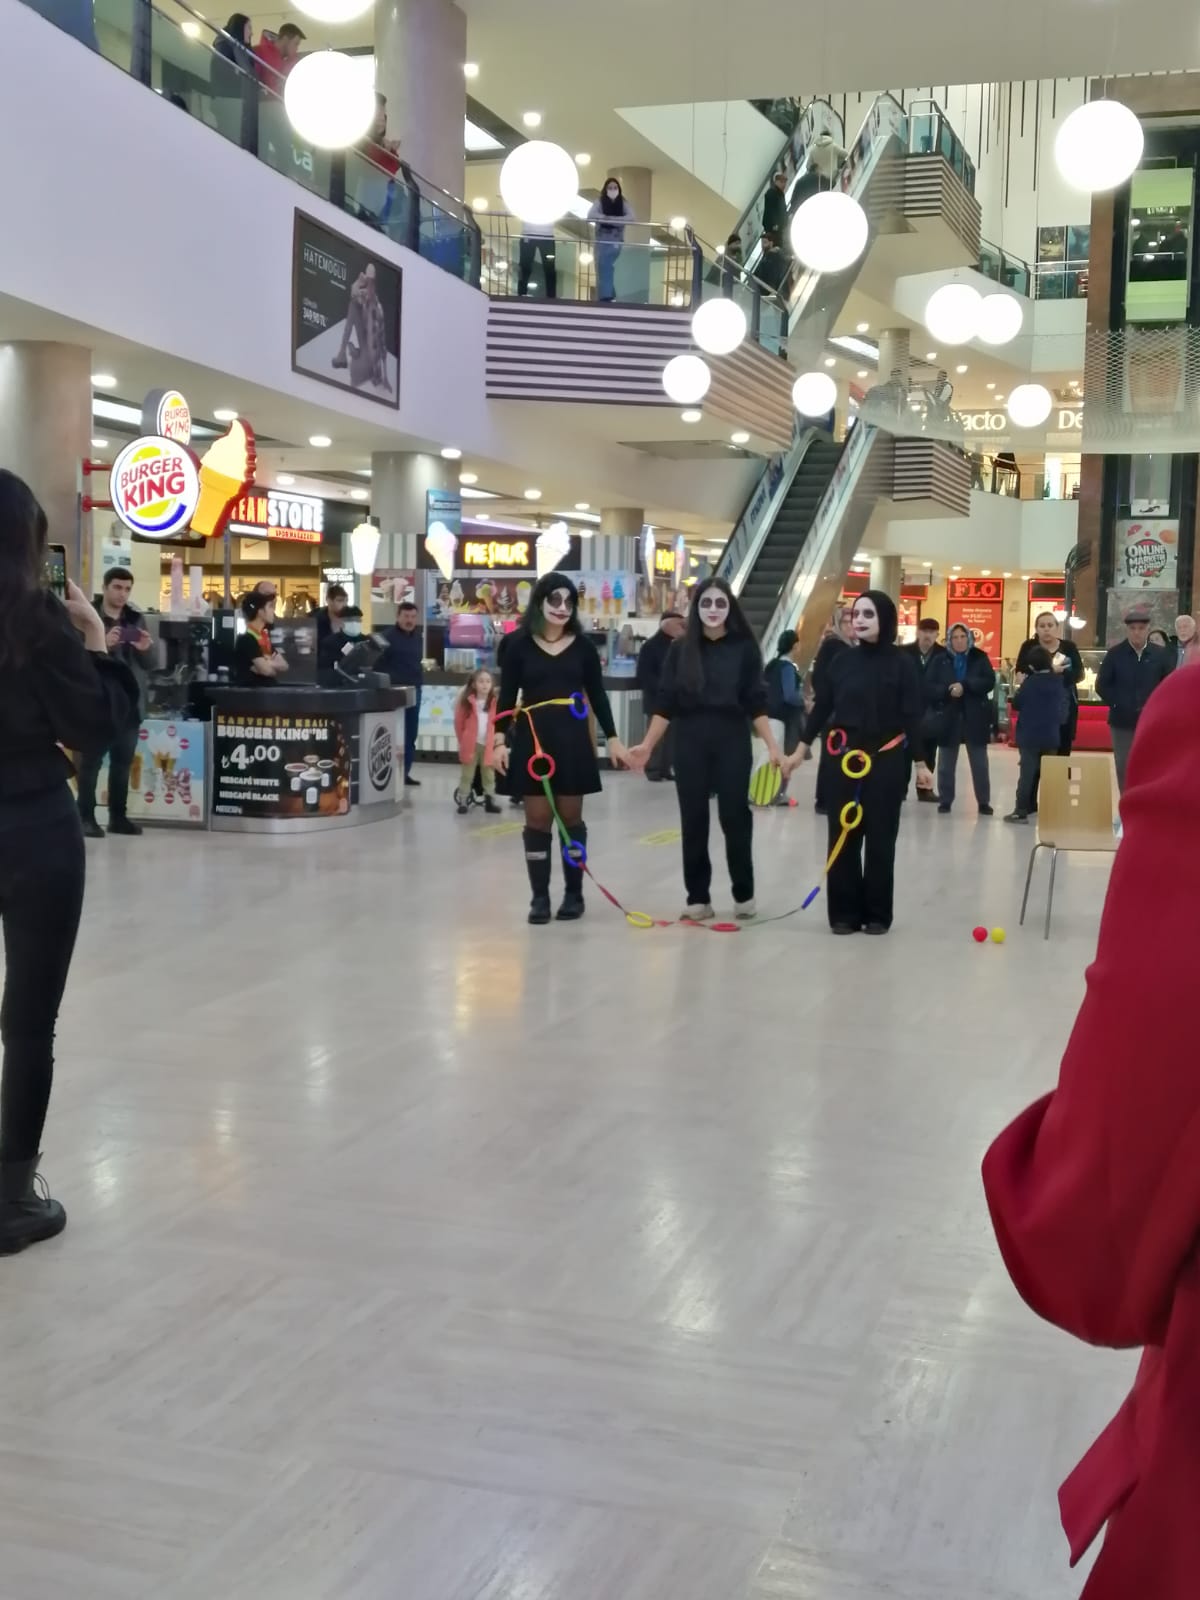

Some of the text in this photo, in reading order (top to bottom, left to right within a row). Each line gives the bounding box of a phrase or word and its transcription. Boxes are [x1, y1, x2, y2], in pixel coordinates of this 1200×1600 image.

[164, 419, 190, 438] KING
[121, 457, 183, 488] BURGER
[123, 472, 185, 513] KING
[268, 498, 324, 533] STORE
[1128, 545, 1168, 558] ONLINE
[953, 582, 997, 598] FLO
[217, 725, 273, 740] BURGER
